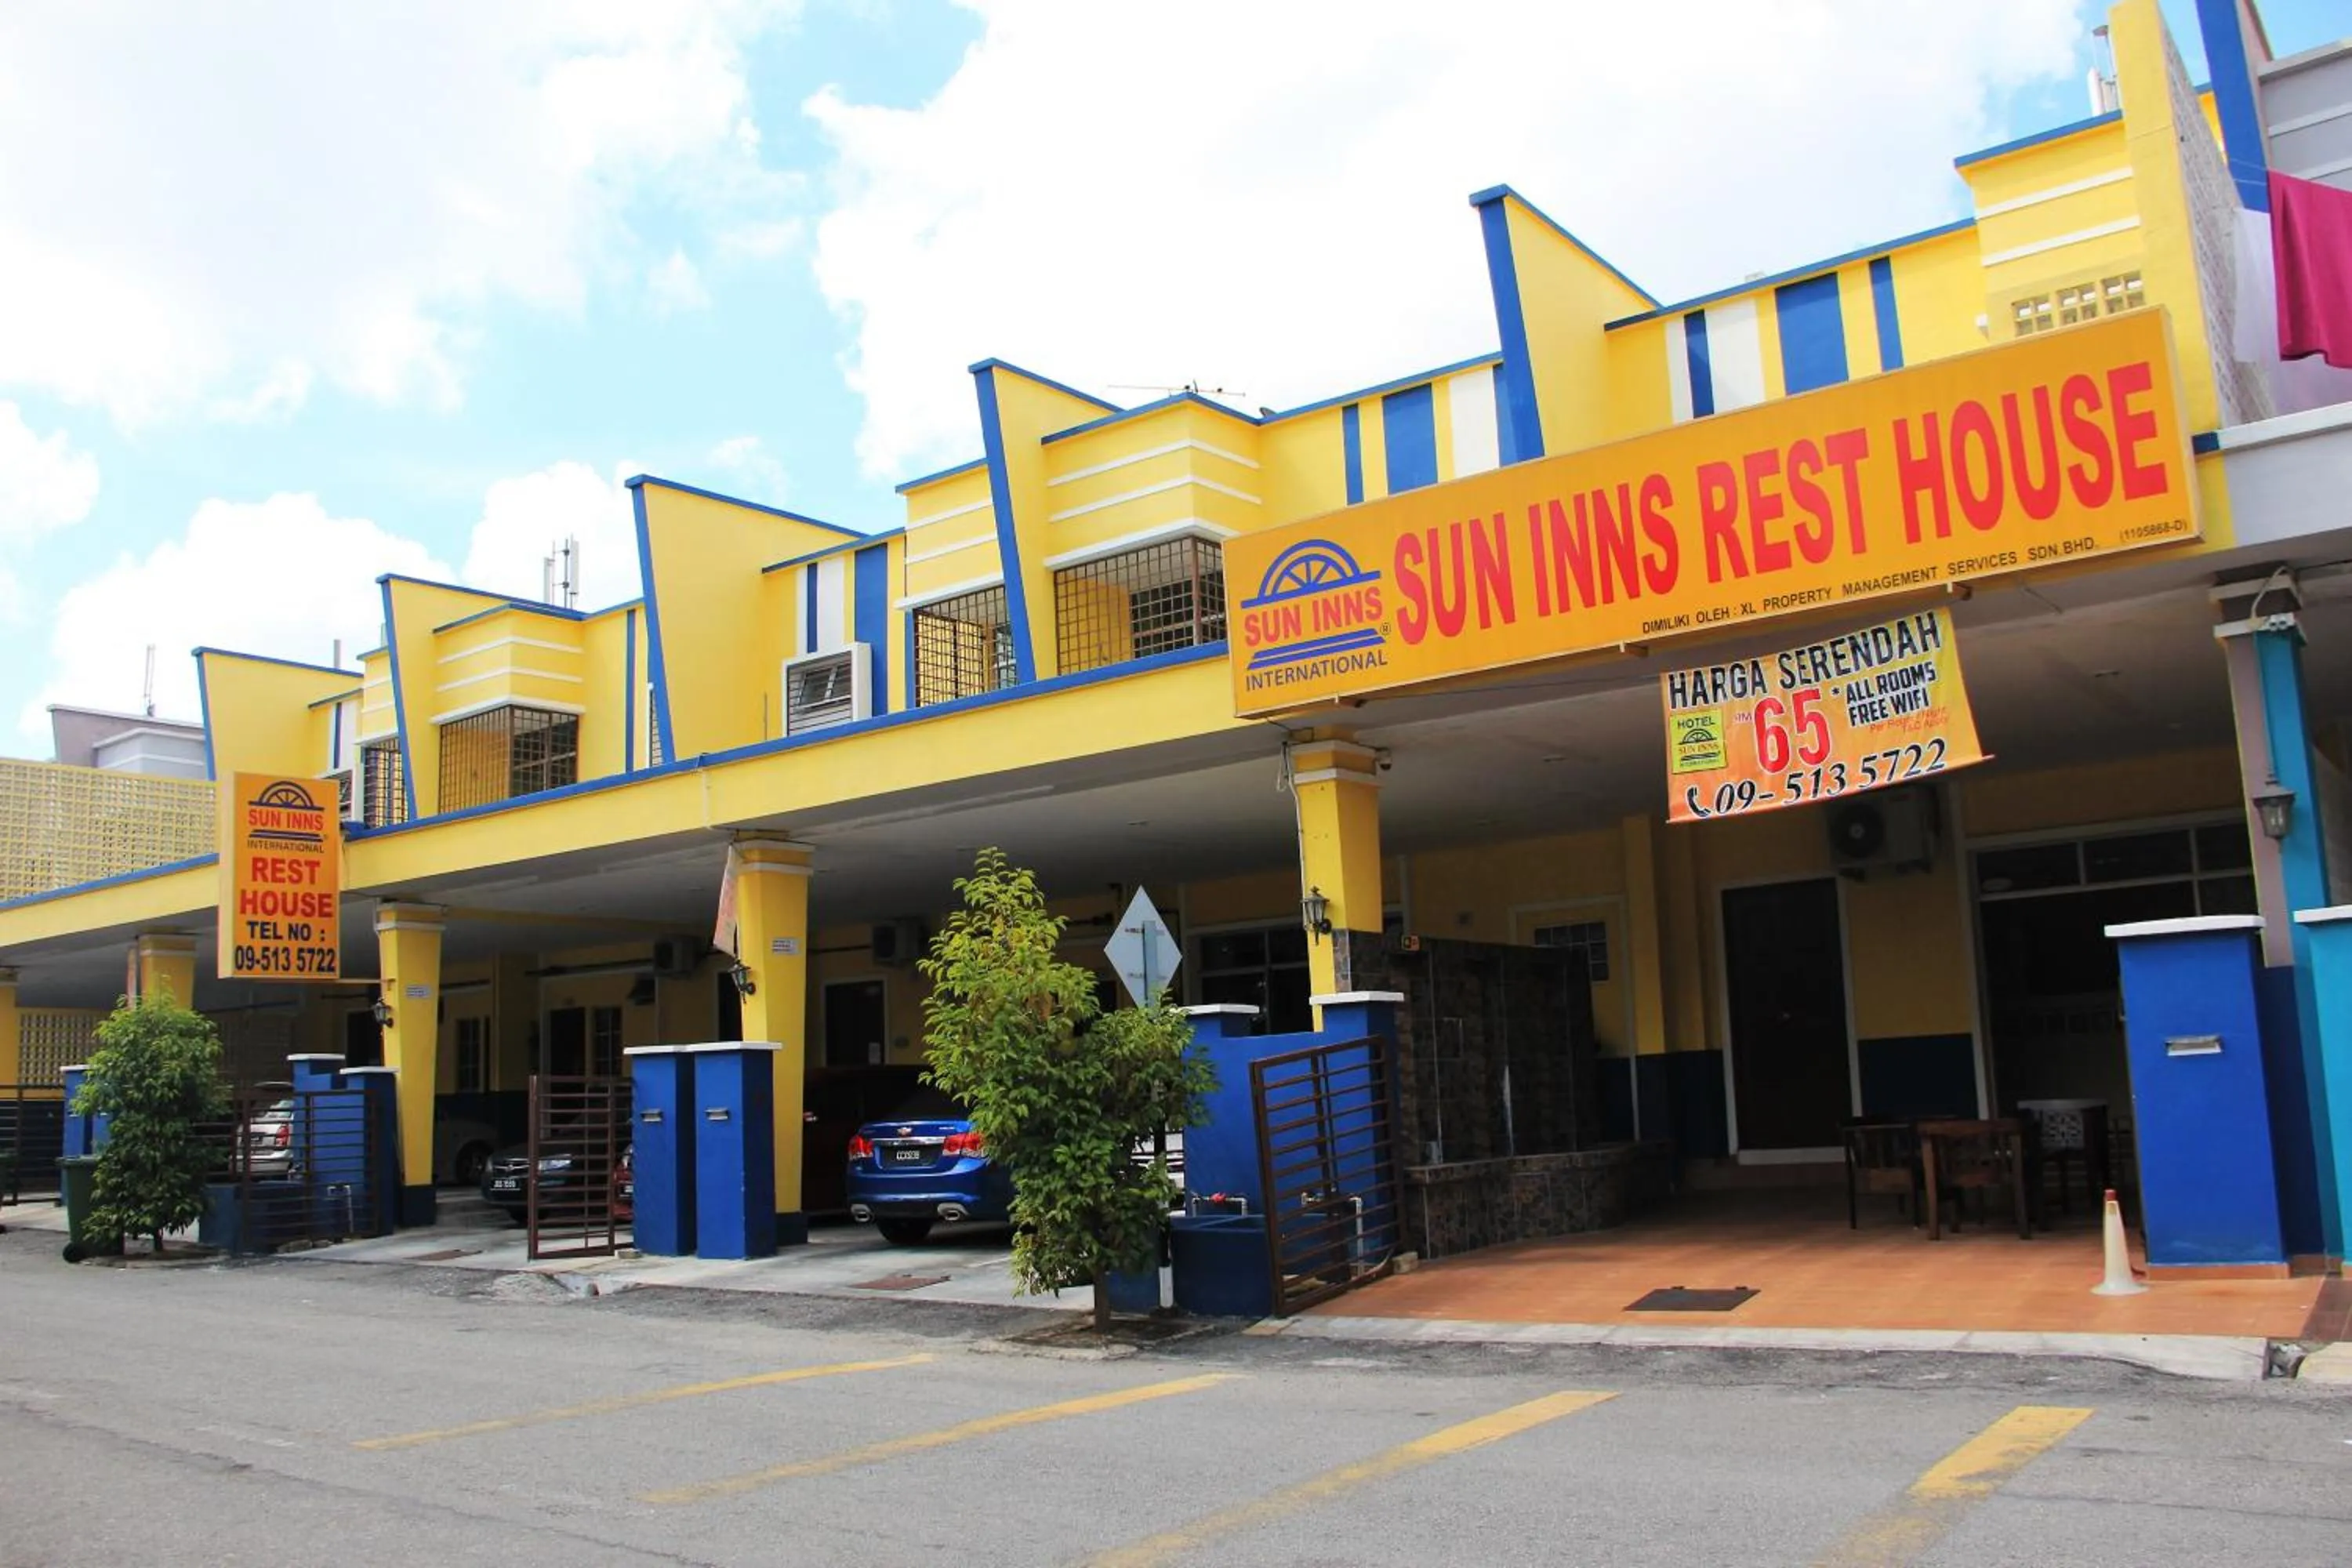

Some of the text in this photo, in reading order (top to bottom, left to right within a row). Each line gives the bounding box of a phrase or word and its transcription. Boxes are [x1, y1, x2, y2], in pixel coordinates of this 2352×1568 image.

[1395, 361, 2168, 645] SUN INNS REST HOUSE
[1642, 615, 1690, 633] DIMILIKI
[1696, 607, 1730, 623] OLEH
[1740, 602, 1756, 615] XL
[1763, 587, 1832, 611] PROPERTY
[1842, 566, 1938, 597] MANAGEMENT
[1947, 551, 2017, 575] SERVICES
[1244, 586, 1382, 647] SUN INNS
[1246, 649, 1388, 691] INTERNATIONAL
[1668, 612, 1941, 709] HARGA SERENDAH
[1846, 662, 1936, 704] ALL ROOMS
[1677, 715, 1715, 729] HOTEL
[1849, 699, 1889, 726] FREE
[1890, 688, 1929, 714] WIFI
[1755, 688, 1831, 773] 65
[1782, 762, 1848, 804] 513
[1857, 738, 1945, 789] 5722
[249, 808, 324, 831] SUN INNS
[247, 840, 325, 853] INTERNATIONAL
[251, 857, 321, 884] REST
[239, 889, 333, 917] HOUSE
[246, 921, 282, 940] TEL
[288, 923, 311, 942] NO
[235, 946, 336, 973] 09-513 5722
